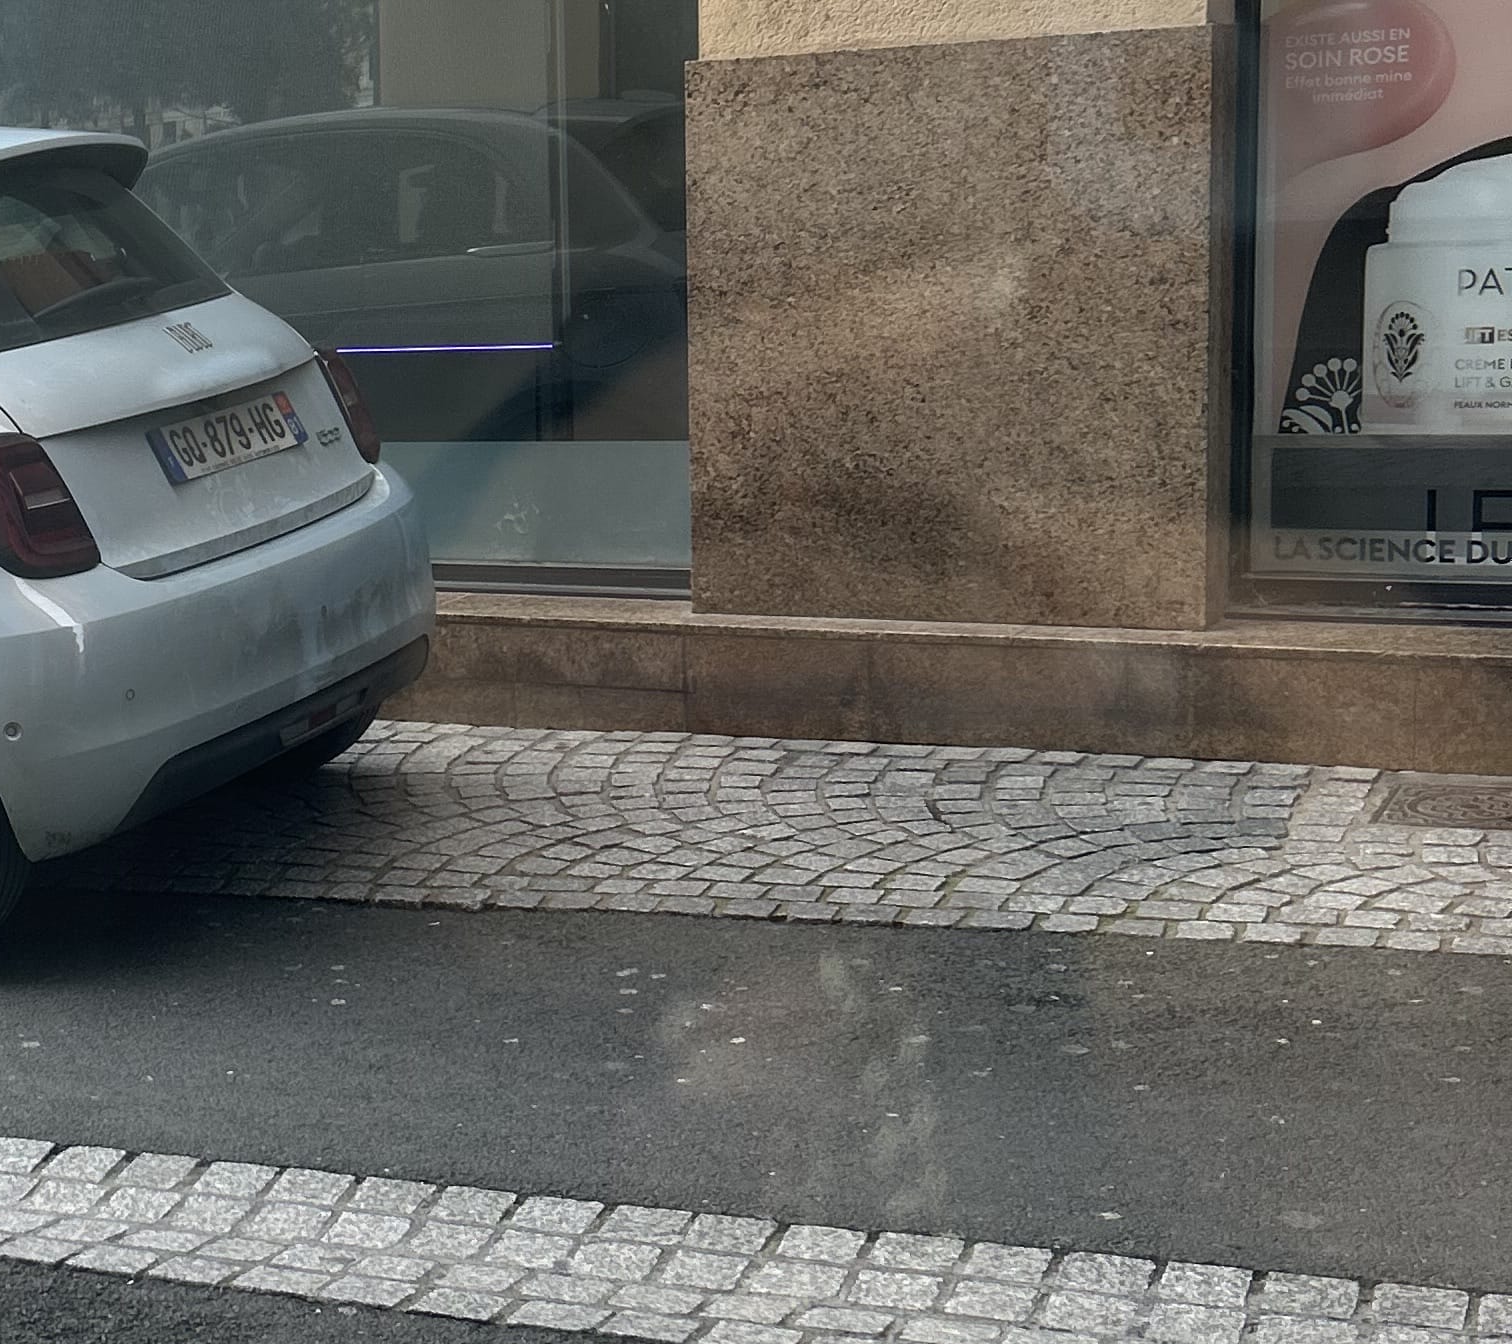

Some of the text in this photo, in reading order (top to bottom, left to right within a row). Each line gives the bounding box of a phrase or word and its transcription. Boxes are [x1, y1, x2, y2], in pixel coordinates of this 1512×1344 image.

[1286, 27, 1411, 48] EXISTE AUSSI EN
[1285, 45, 1410, 70] SOIN ROSE
[1286, 69, 1414, 89] Effet bonne mine
[1312, 87, 1385, 104] immédiat
[1454, 376, 1481, 388] LIFT
[1484, 376, 1495, 388] &
[169, 403, 286, 467] GQ-879-HG
[1275, 536, 1309, 561] LA
[1318, 536, 1456, 564] SCIENCE
